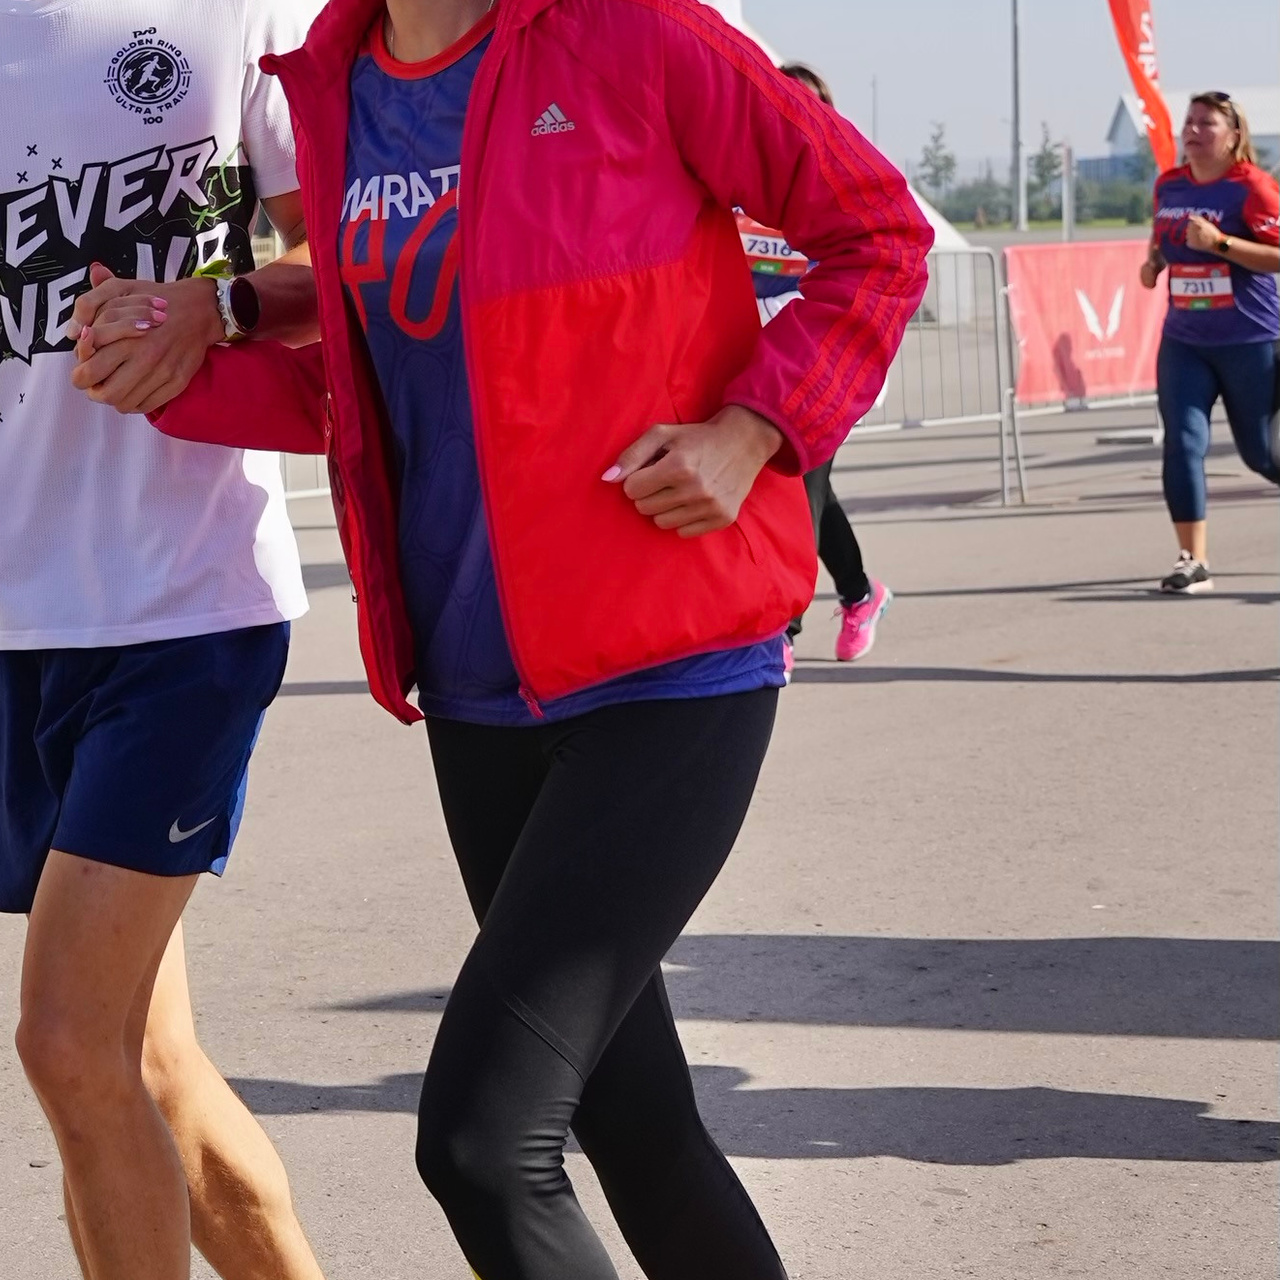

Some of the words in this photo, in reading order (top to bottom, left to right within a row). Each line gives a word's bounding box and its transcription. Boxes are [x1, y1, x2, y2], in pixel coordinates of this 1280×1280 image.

[111, 38, 153, 65] GOLDEN
[157, 39, 182, 58] RING
[115, 95, 152, 115] ULTRA
[156, 89, 188, 113] TRAIL
[142, 115, 164, 125] 100
[530, 121, 575, 137] adidas
[747, 238, 793, 257] 7316
